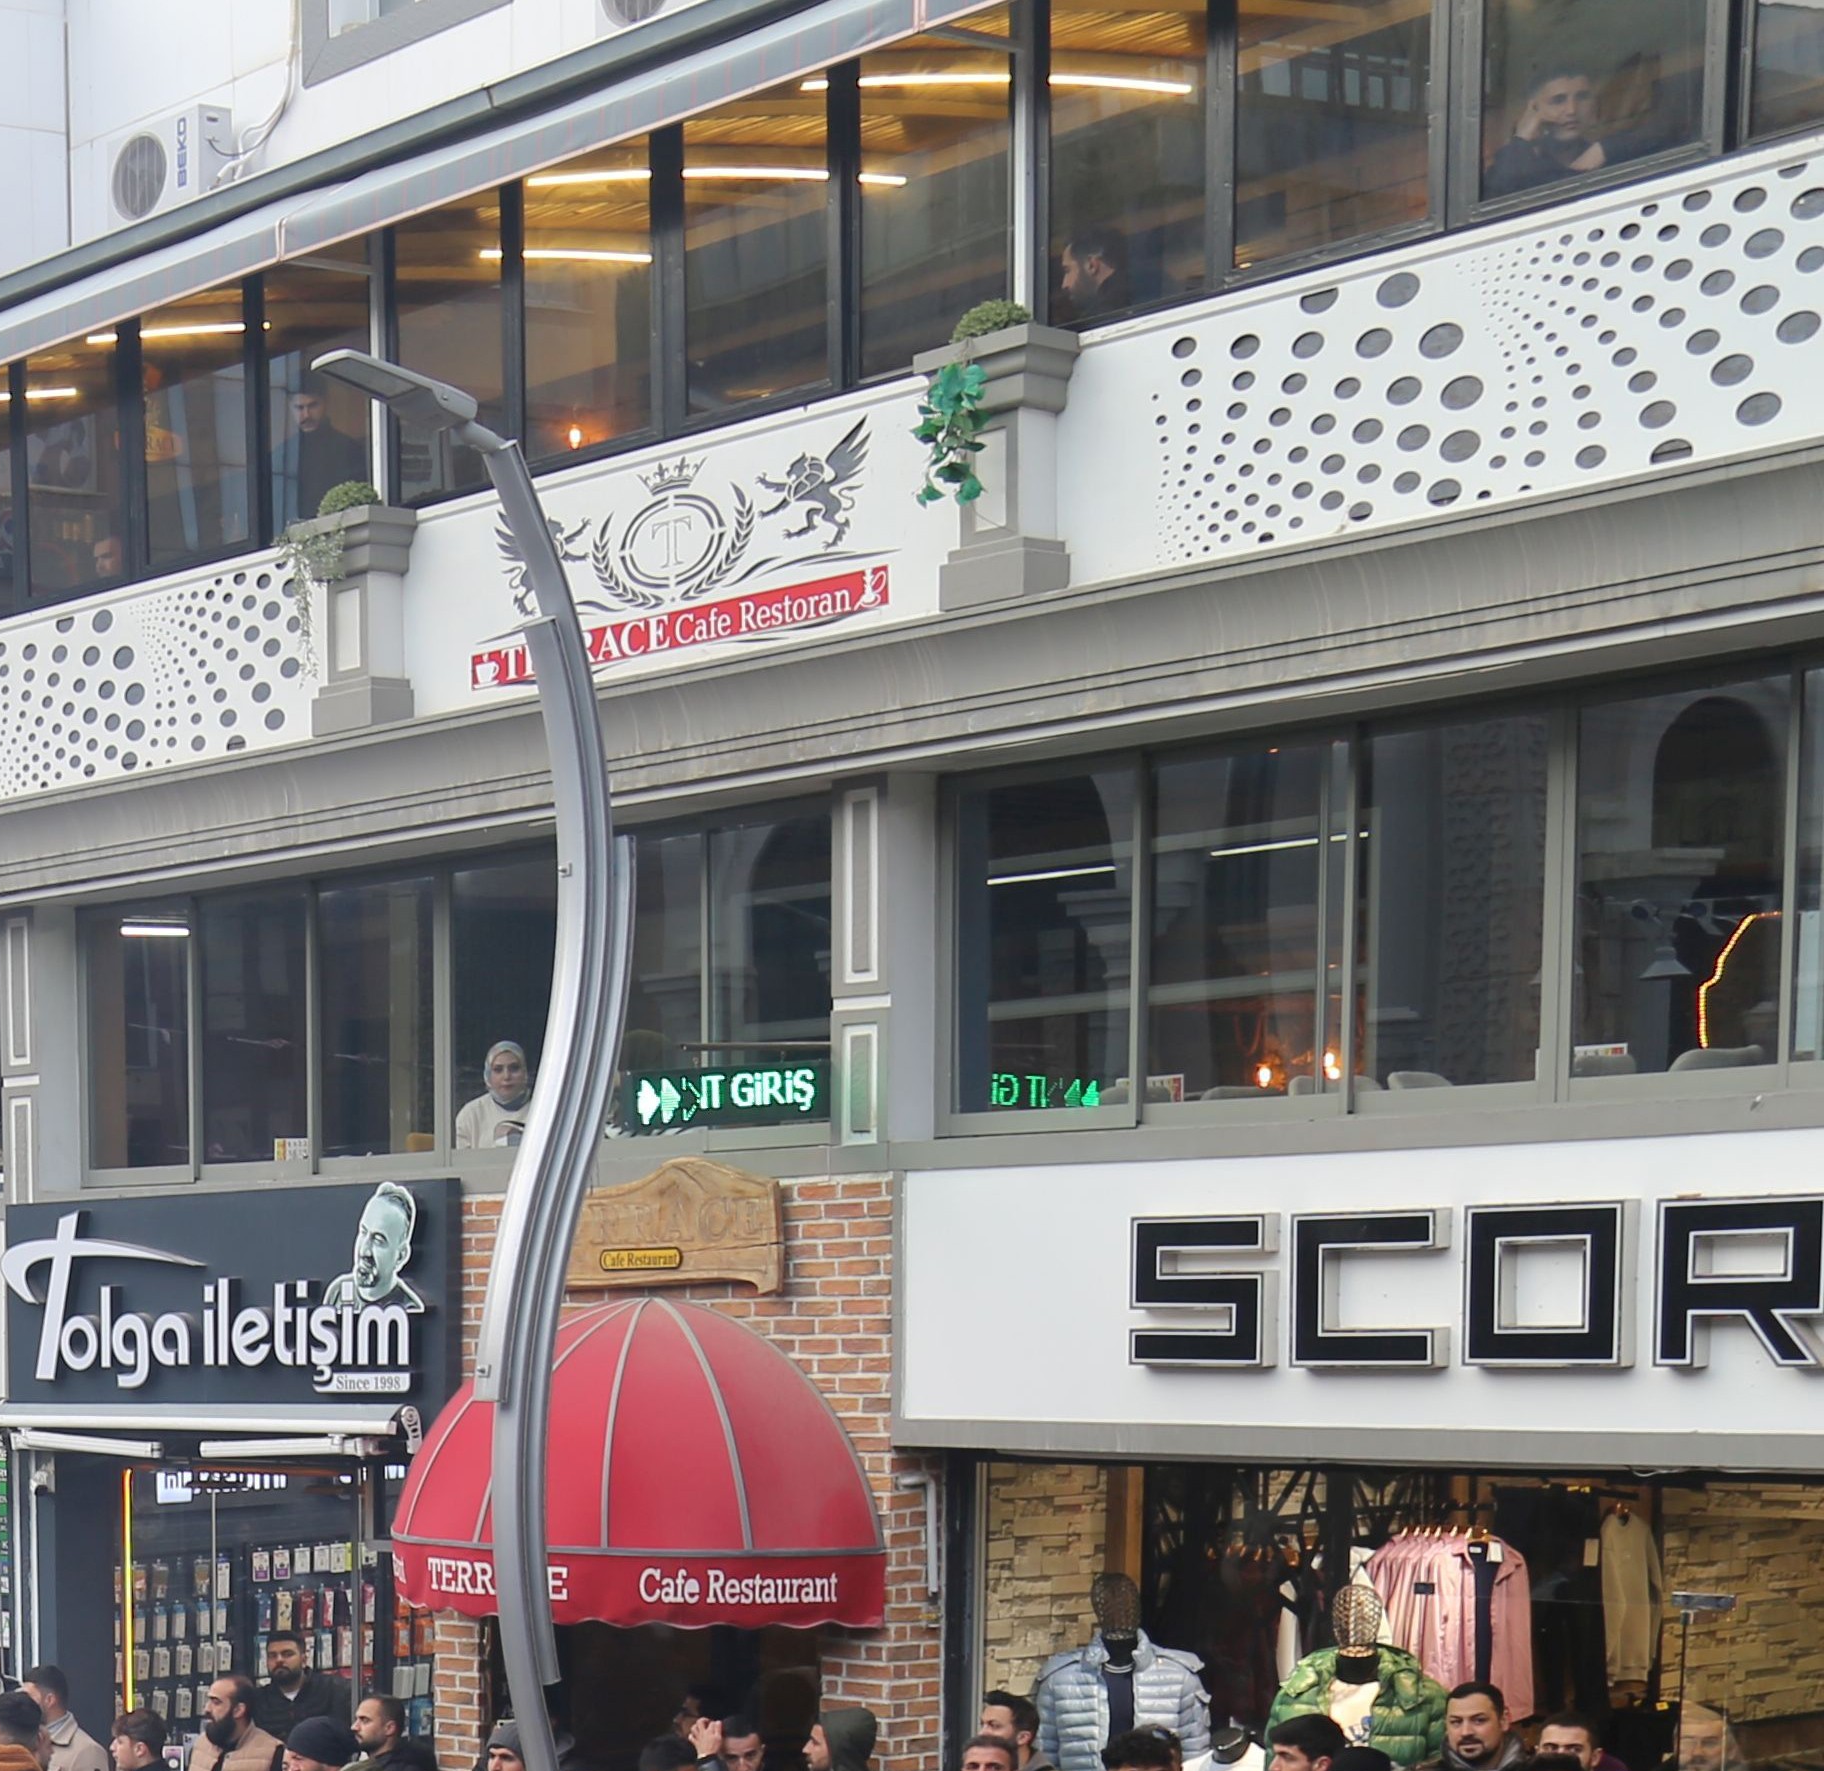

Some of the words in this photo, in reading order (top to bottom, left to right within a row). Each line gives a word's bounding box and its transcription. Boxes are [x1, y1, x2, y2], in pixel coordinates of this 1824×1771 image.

[675, 608, 733, 644] Cafe
[739, 587, 851, 633] Restoran
[602, 1249, 626, 1268] Cafe
[627, 1248, 680, 1267] Restaurant
[0, 1210, 209, 1389] Tolga
[201, 1276, 411, 1382] iletişim
[1128, 1196, 1824, 1371] SCOR
[335, 1373, 371, 1392] Since
[373, 1373, 402, 1391] 1998
[638, 1567, 701, 1604] Cafe
[705, 1571, 839, 1605] Restaurant
